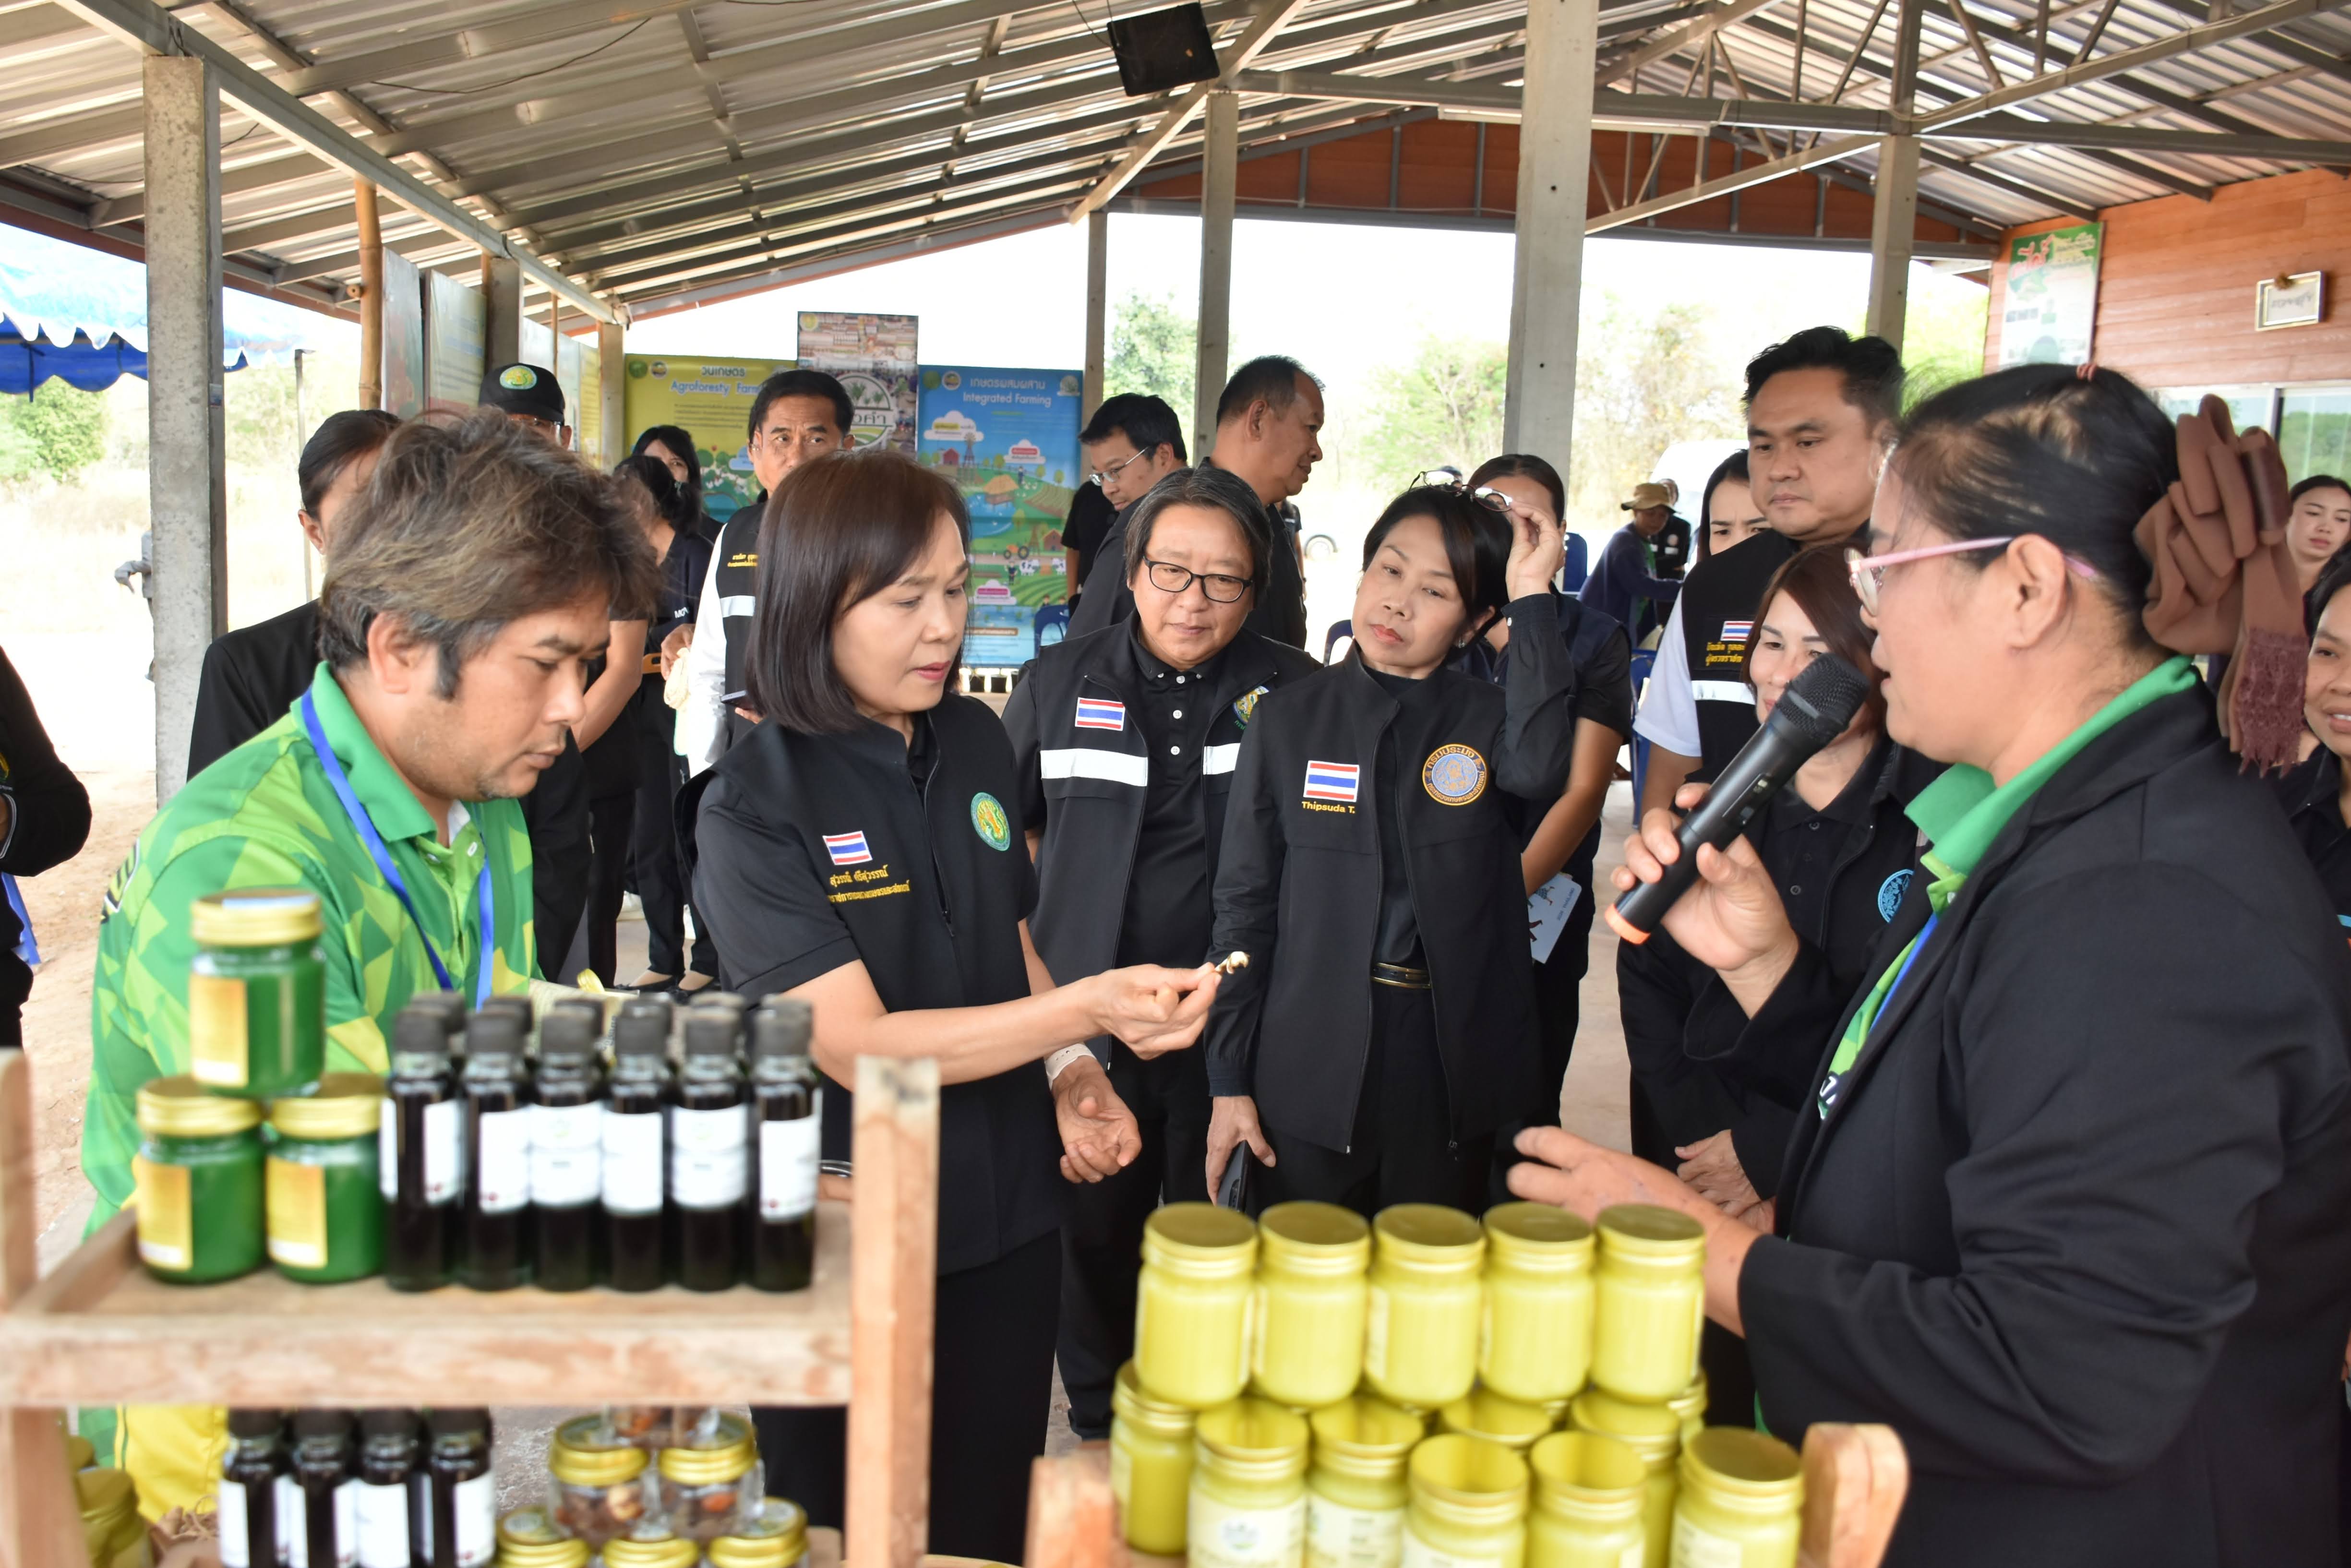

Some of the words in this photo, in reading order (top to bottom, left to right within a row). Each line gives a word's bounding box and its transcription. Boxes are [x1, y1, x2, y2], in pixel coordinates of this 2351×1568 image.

[701, 366, 746, 377] วนเกษตร
[671, 380, 730, 396] Agroforesty
[737, 383, 760, 394] Farm
[970, 378, 1046, 390] เกษตรผสมผสาน
[963, 393, 1012, 406] Integrated
[1015, 395, 1052, 407] Farming
[1427, 747, 1475, 768] กรมประมง
[1302, 801, 1345, 813] Thipsuda
[1348, 806, 1355, 814] T.
